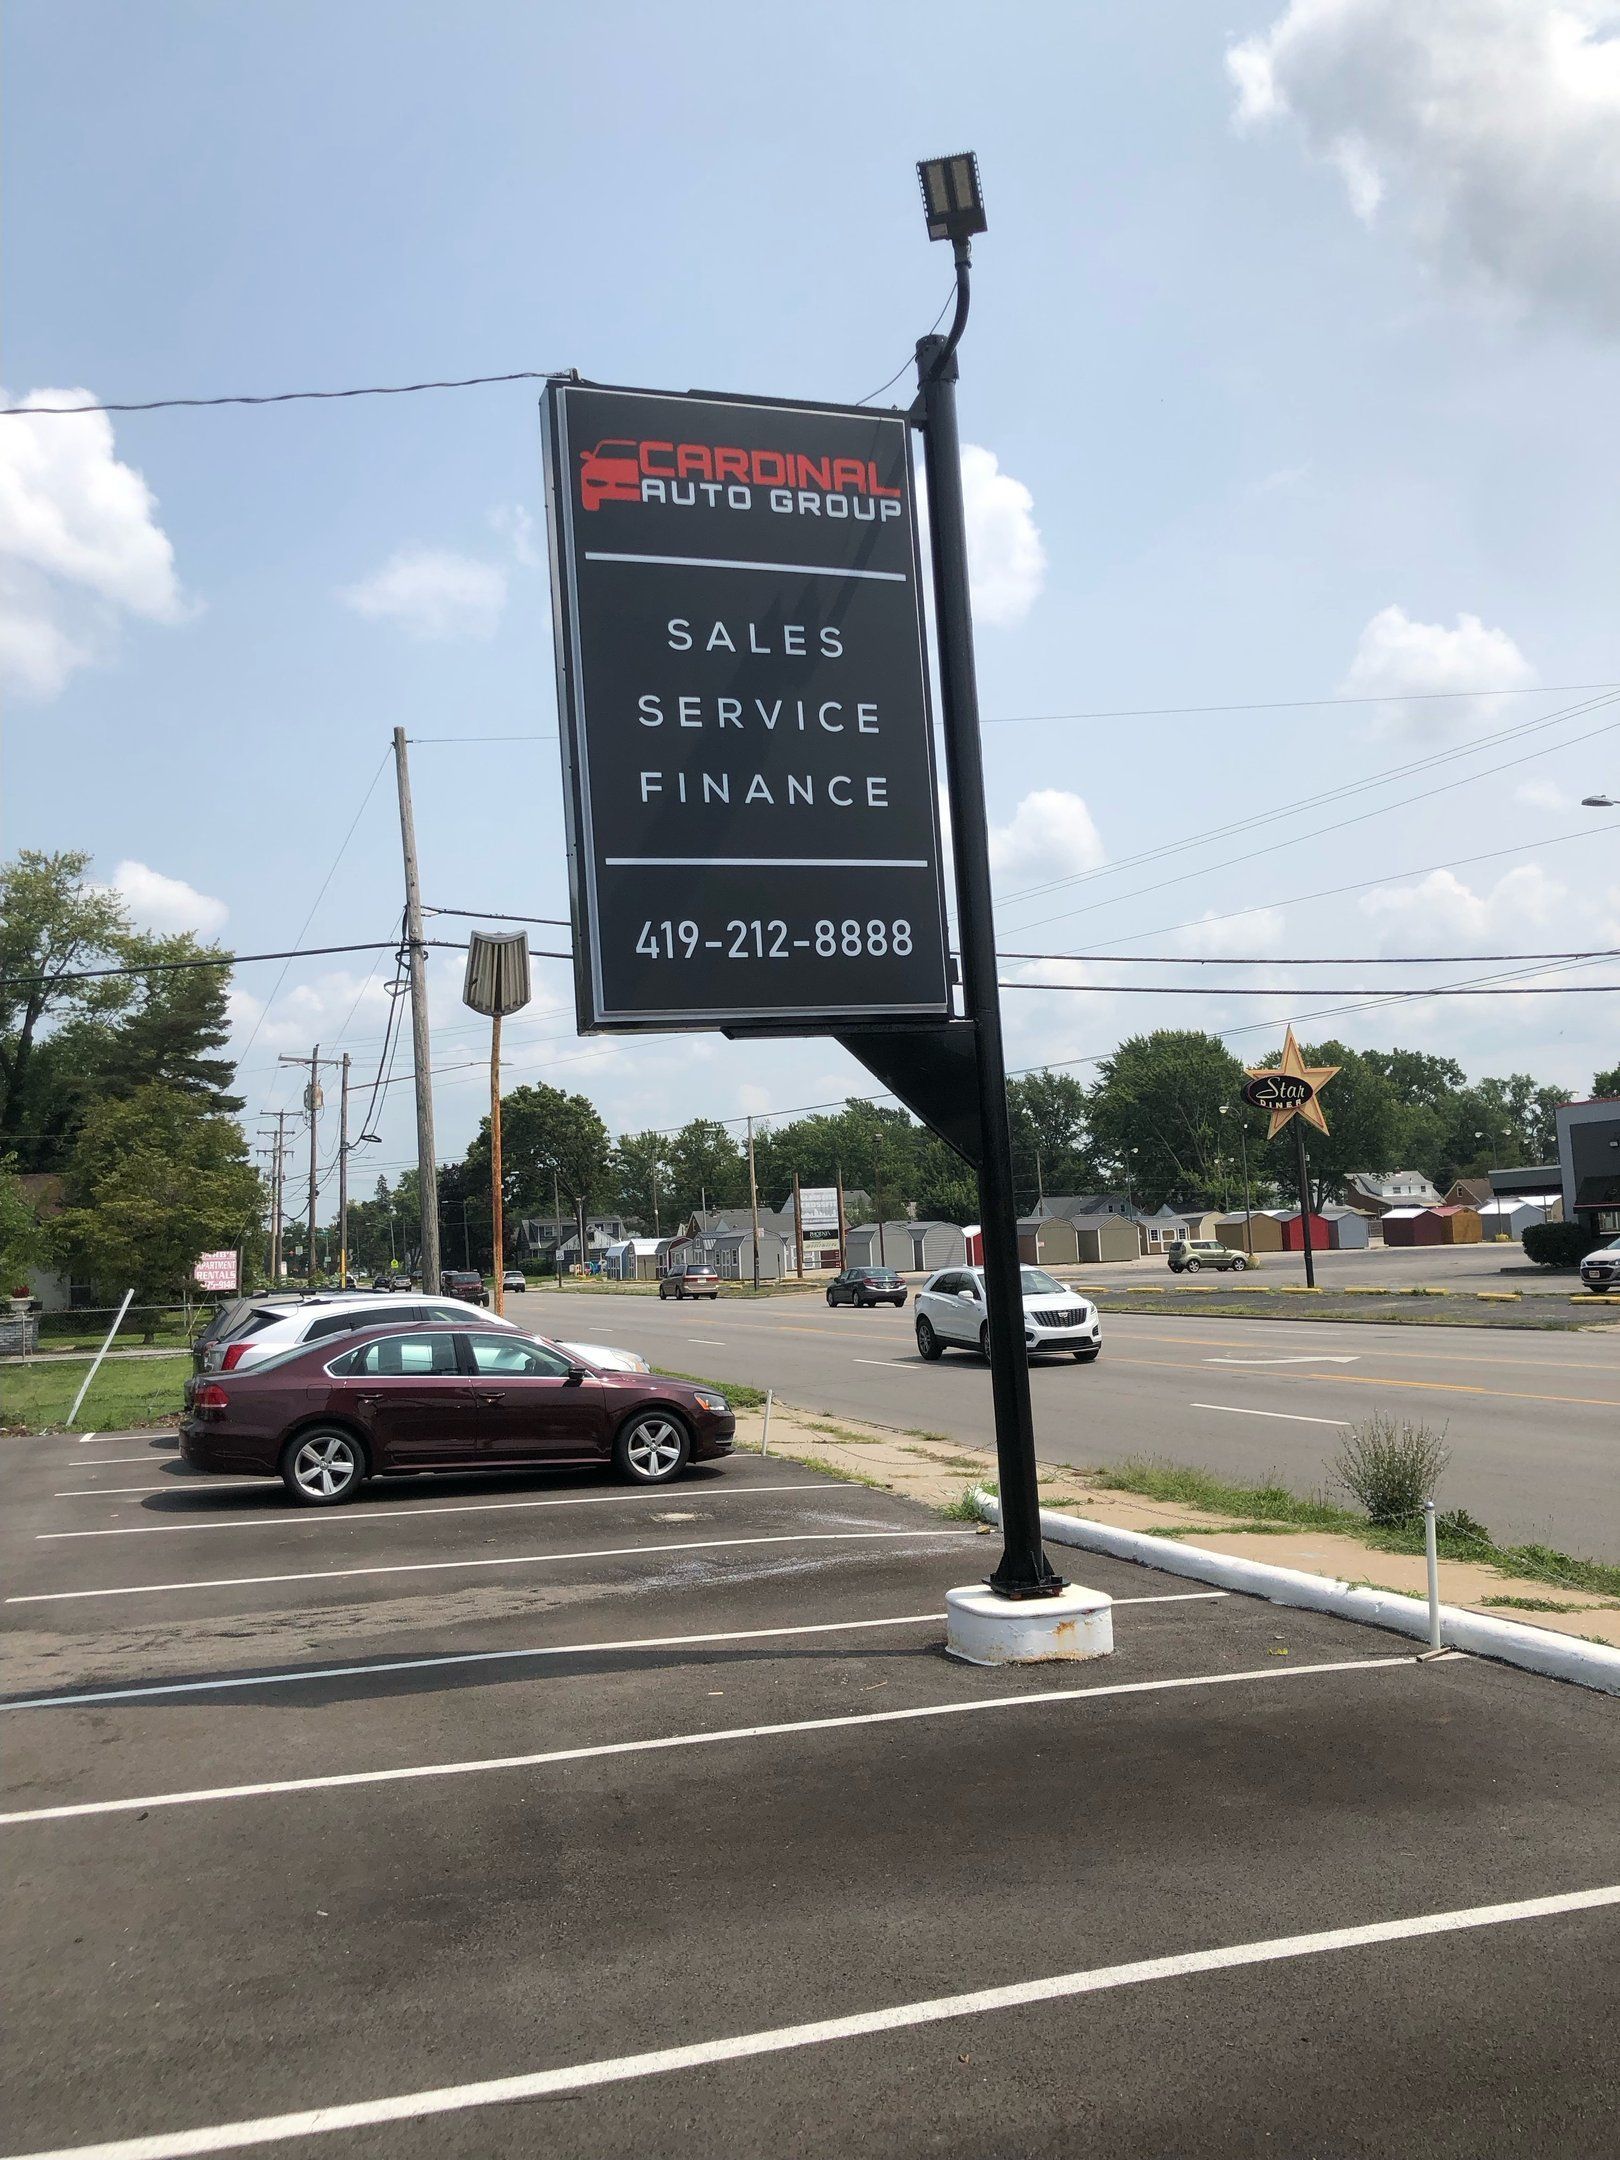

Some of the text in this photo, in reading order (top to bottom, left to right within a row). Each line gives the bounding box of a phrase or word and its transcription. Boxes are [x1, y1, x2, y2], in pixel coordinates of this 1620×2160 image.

[639, 441, 901, 497] CARDINAL
[641, 478, 901, 522] AUTO GROUP
[667, 618, 844, 658] SALES
[638, 694, 880, 734] SERVICE
[640, 771, 889, 807] FINANCE
[635, 919, 913, 959] 419-212-8888
[1255, 1077, 1305, 1099] Star
[1260, 1099, 1302, 1108] DINER
[196, 1261, 236, 1270] APARTMENT
[196, 1271, 236, 1280] RENTALS
